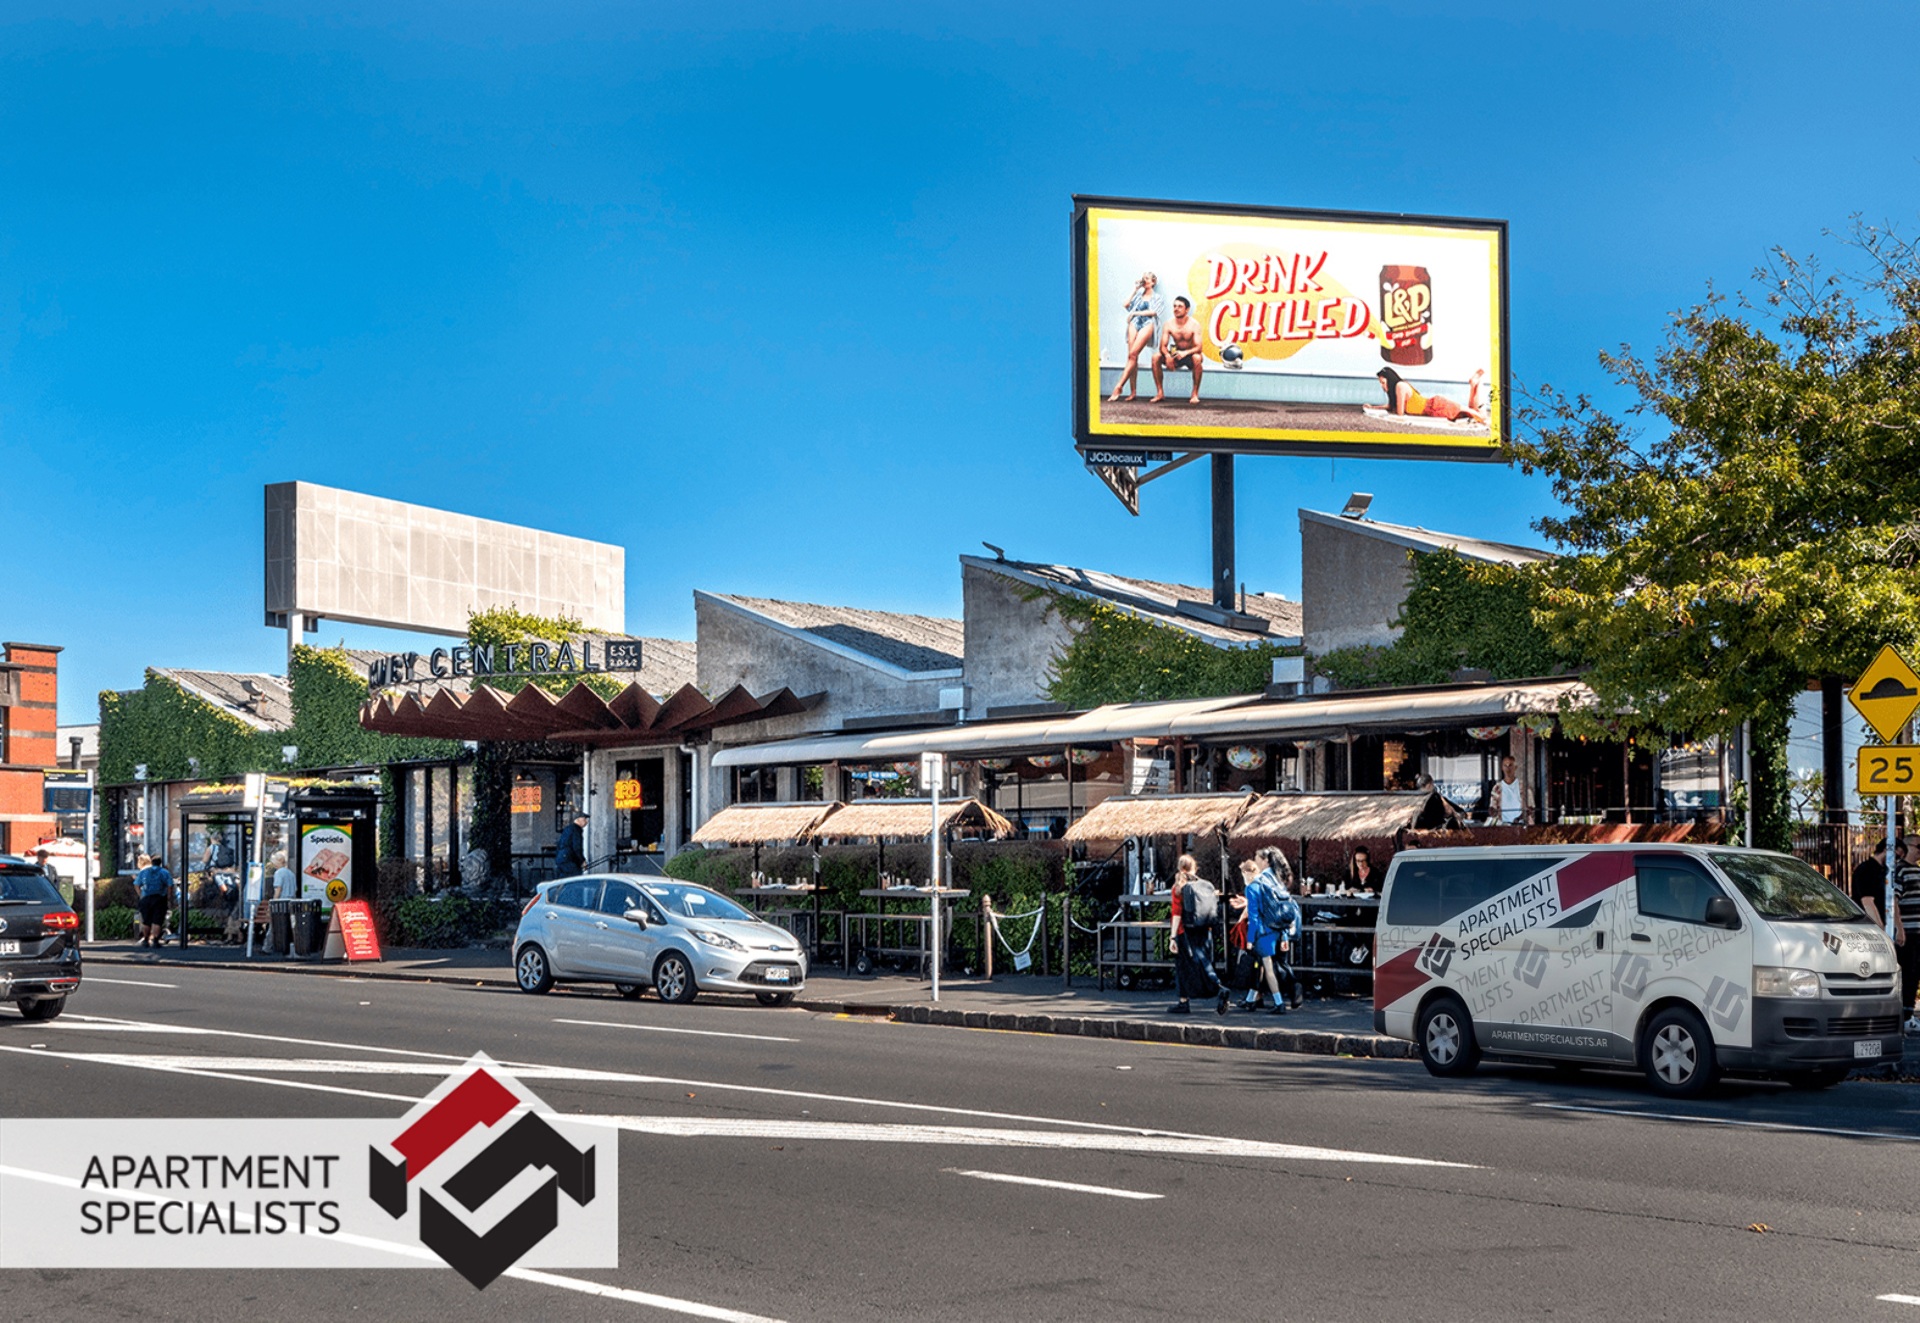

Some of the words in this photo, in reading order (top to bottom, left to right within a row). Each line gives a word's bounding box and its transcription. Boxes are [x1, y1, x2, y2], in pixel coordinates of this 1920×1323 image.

[1384, 283, 1430, 328] L&P
[1089, 452, 1143, 464] JCDecaux
[430, 640, 600, 677] CENTRAL
[1869, 757, 1914, 784] 25
[310, 834, 344, 845] Specials
[1458, 874, 1553, 937] APARTMENT
[1460, 897, 1558, 961] SPECIALISTS
